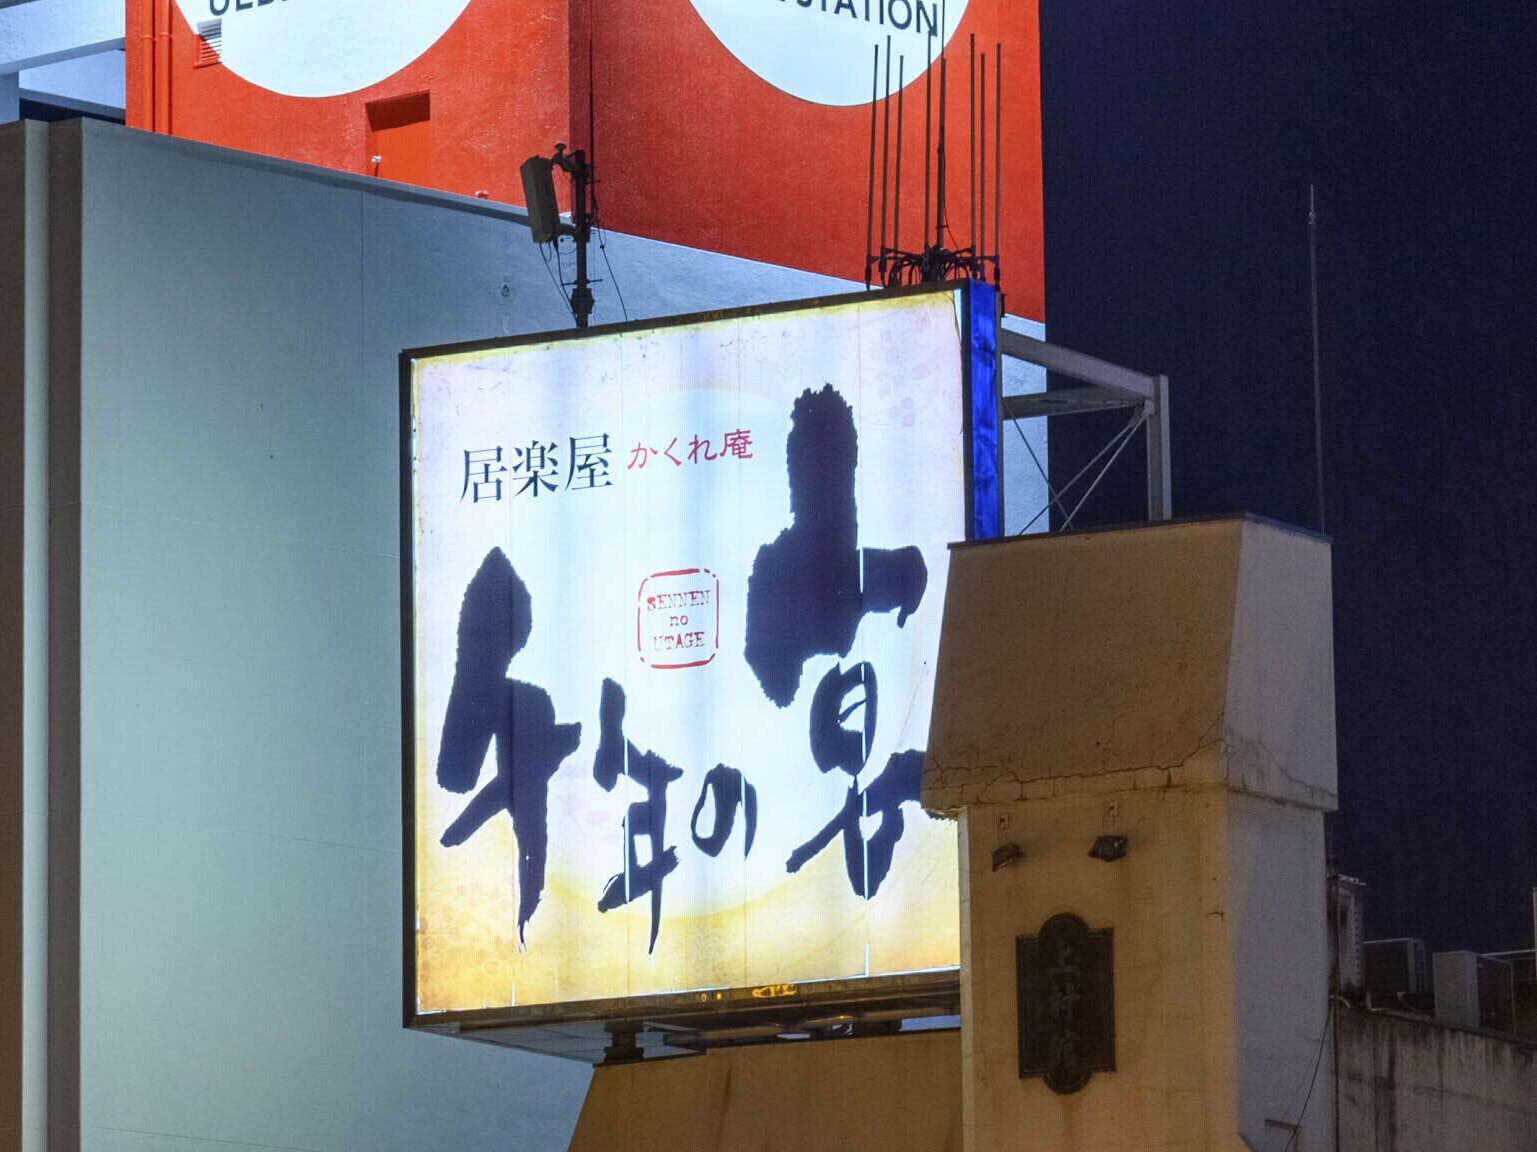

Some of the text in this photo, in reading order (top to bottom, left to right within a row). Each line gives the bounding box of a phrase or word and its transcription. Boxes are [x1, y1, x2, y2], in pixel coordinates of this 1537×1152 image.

[459, 428, 754, 504] 居楽屋 かくれ庵
[646, 589, 711, 611] SENNEN
[669, 615, 689, 627] no
[653, 631, 705, 652] UTAGE
